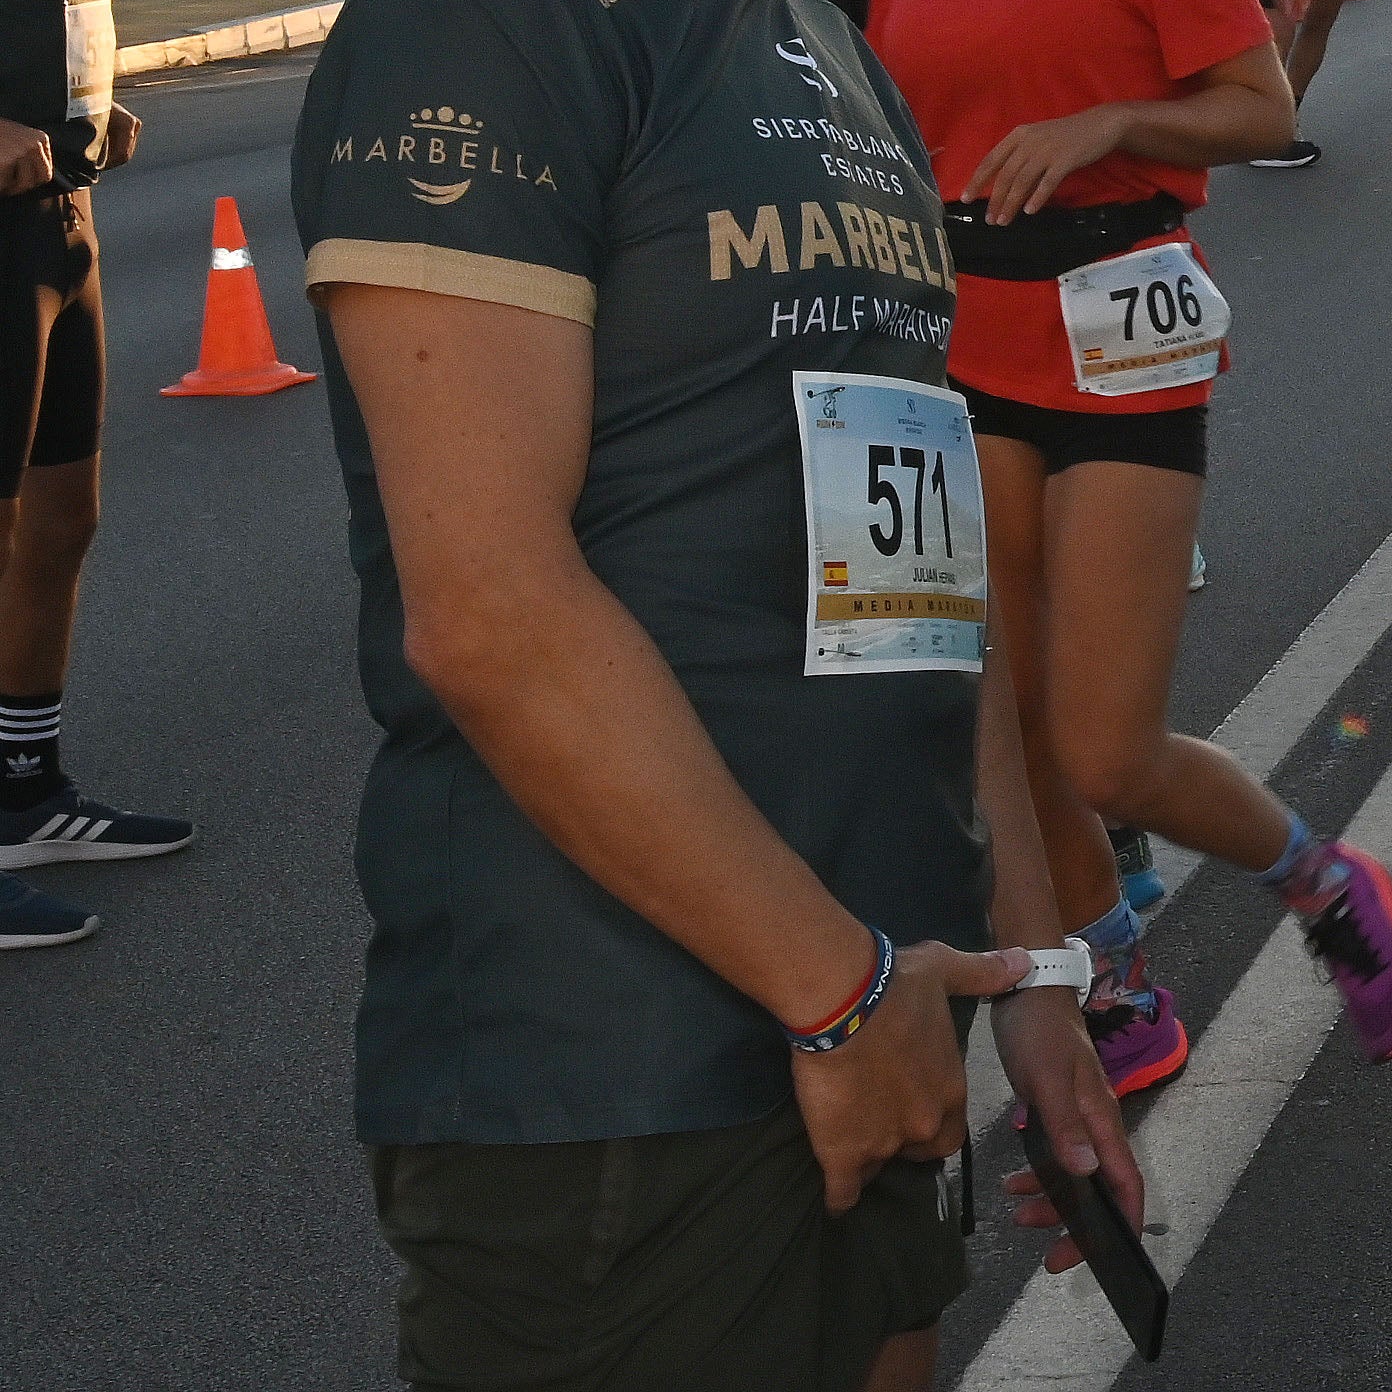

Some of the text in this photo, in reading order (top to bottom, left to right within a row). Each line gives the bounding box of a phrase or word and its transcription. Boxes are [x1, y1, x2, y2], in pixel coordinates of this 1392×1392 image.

[330, 134, 559, 192] MARBELLA
[707, 201, 957, 296] MARBELL
[771, 294, 953, 352] HALF MARATHO
[1109, 274, 1202, 341] 706
[867, 444, 953, 559] 571
[853, 599, 915, 613] MEDIA
